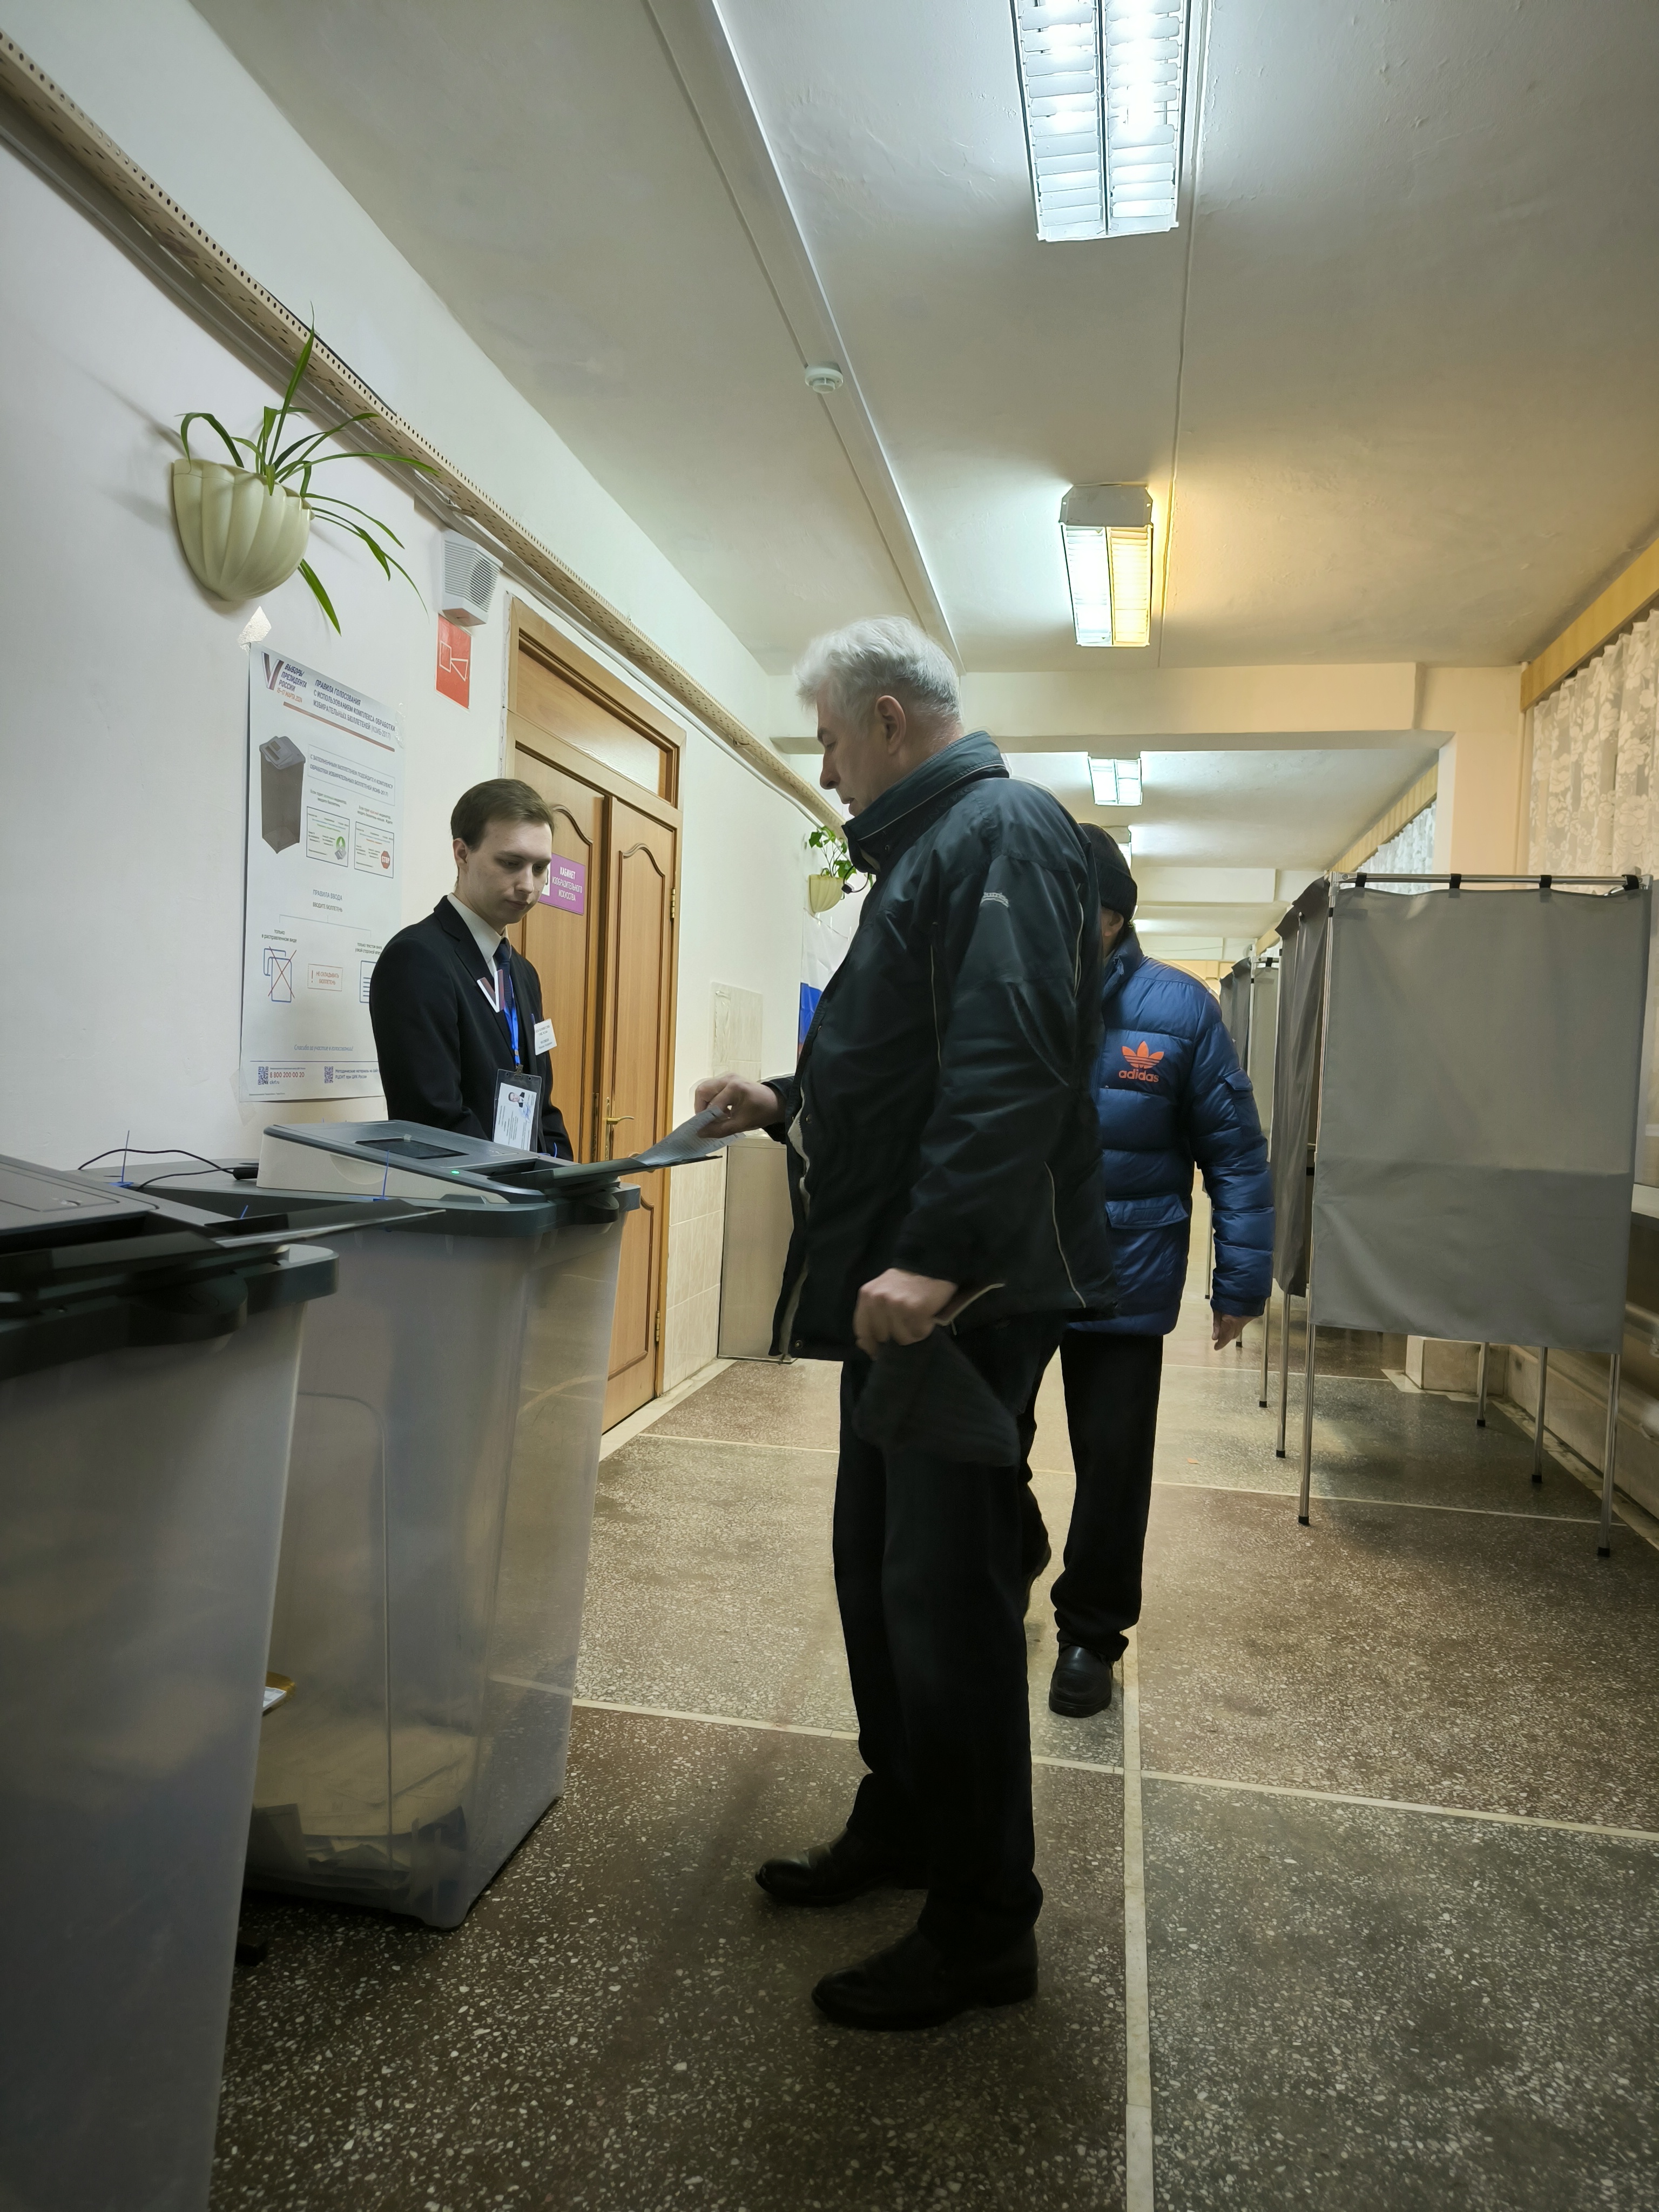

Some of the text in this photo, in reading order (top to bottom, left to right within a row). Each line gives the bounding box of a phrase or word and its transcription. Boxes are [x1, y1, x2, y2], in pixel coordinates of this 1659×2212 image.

[285, 664, 305, 677] ВЫБОРЫ
[279, 679, 296, 692] РОССИИ
[281, 671, 307, 689] ПРЕЗИДЕНТА
[285, 691, 295, 700] МАРТА
[315, 679, 361, 706] ПРАВИЛА ГОЛОСОВАНИЯ
[313, 700, 347, 720] ИЗБИРАТЕЛЬНЫХ
[347, 714, 371, 730] БЮЛЛЕТЕНЕЙ
[317, 691, 353, 713] ИСПОЛЬЗОВАНИЕМ
[353, 707, 375, 723] КОМПЛЕКСА
[375, 718, 396, 732] ОБРАБОТКИ
[310, 764, 328, 775] ОБРАБОТКИ
[328, 771, 354, 784] ИЗБИРАТЕЛЬНЫХ
[381, 855, 390, 864] STOP
[560, 866, 576, 880] КАБИНЕТ
[552, 876, 583, 894] ИЗОБРАЗИТЕЛЬНОГО
[313, 889, 330, 898] ПРАВИЛА
[558, 889, 576, 901] ИСКУССТВА
[1118, 1068, 1159, 1083] adidas
